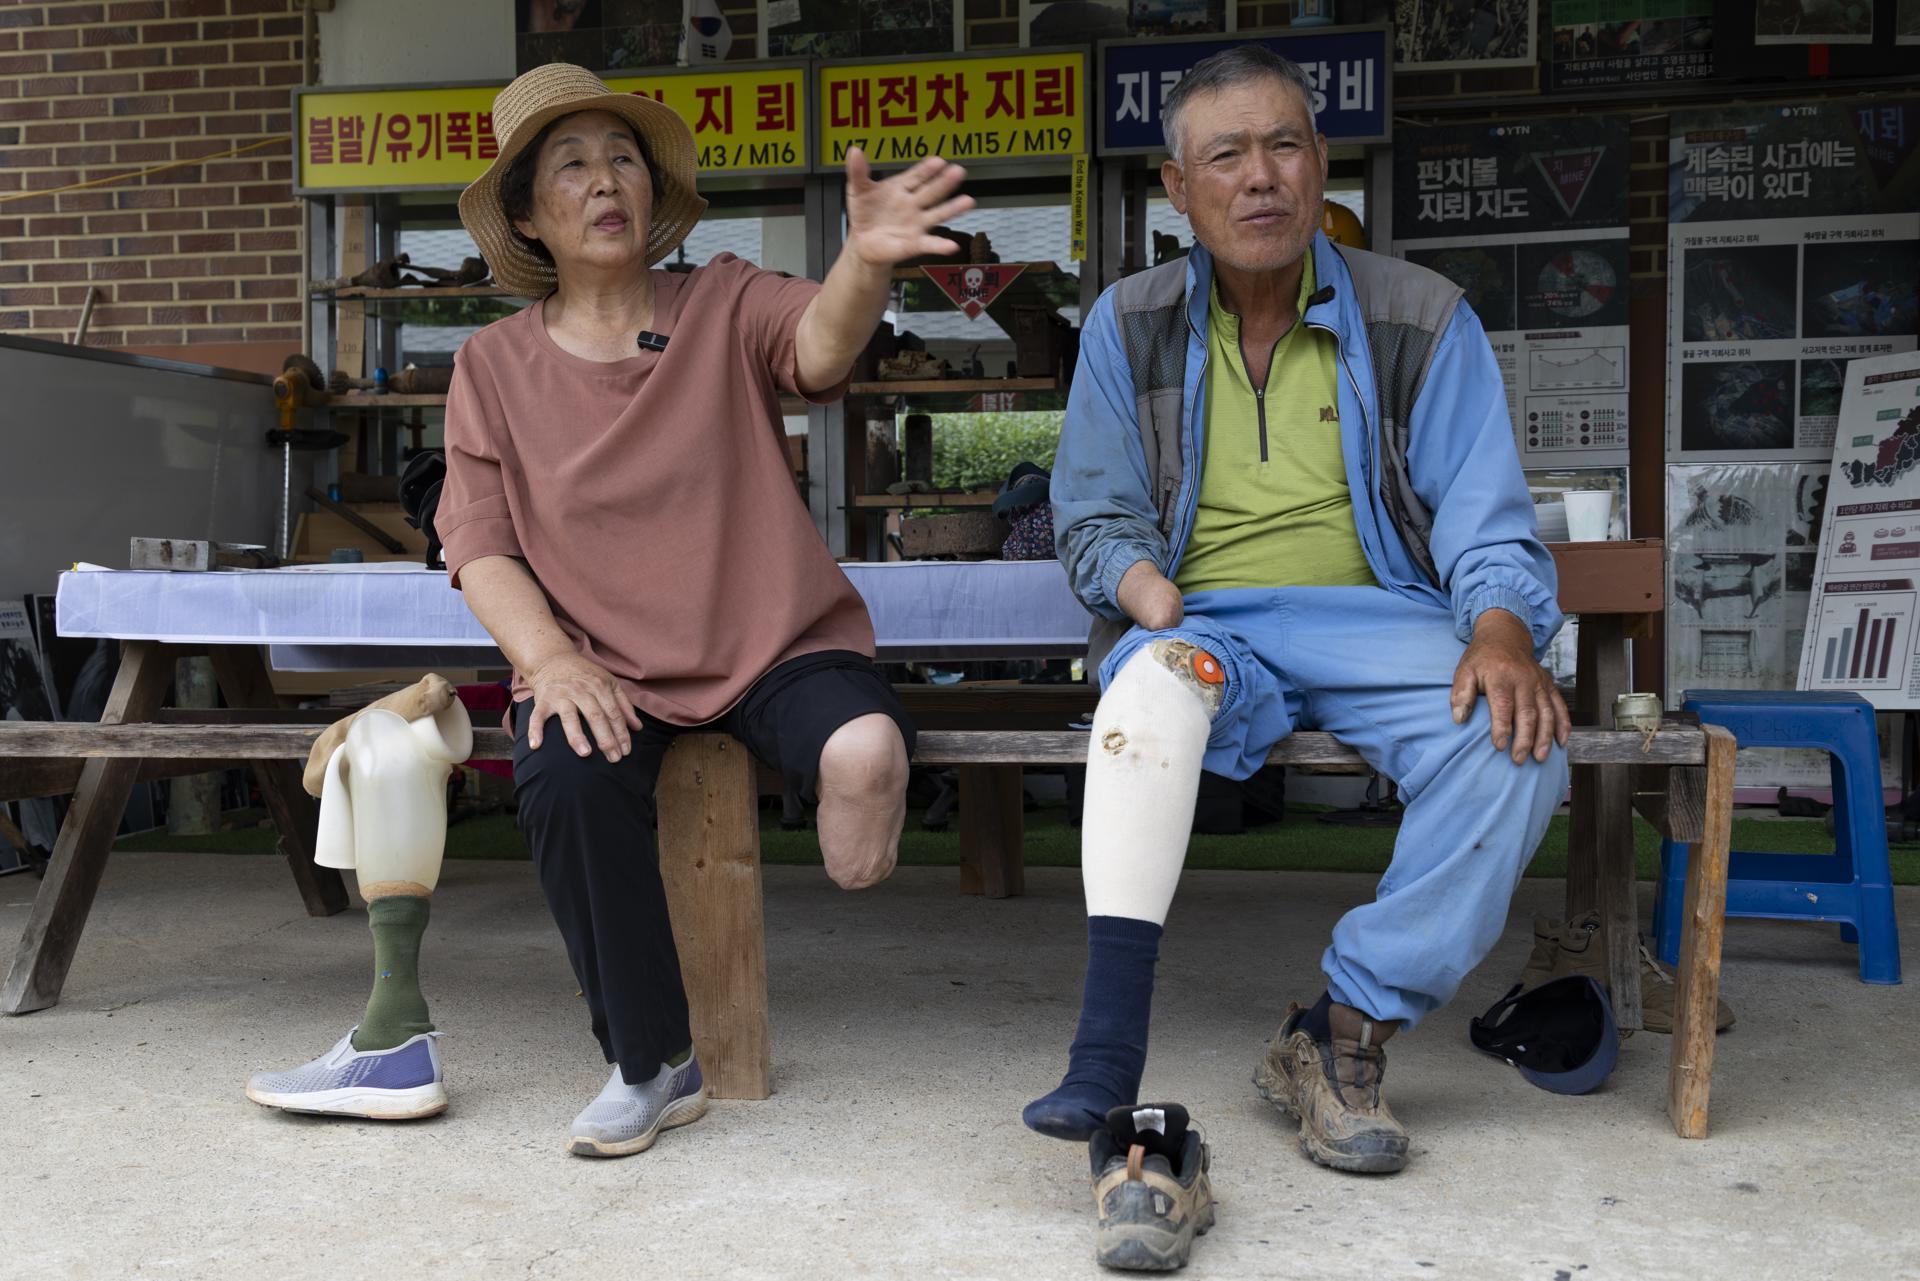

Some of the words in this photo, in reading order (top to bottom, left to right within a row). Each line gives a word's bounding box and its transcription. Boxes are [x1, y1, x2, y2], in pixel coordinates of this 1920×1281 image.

[830, 72, 969, 128] 대전차
[985, 66, 1075, 119] 지뢰
[1793, 106, 1818, 117] YTN
[892, 135, 928, 159] M6
[952, 131, 1000, 155] M15
[1023, 127, 1073, 152] M19
[1506, 125, 1531, 136] YTN
[749, 142, 796, 165] M16
[1076, 159, 1085, 174] End
[1685, 144, 1754, 174] 계속된
[1761, 139, 1857, 170] 사고에는
[1076, 175, 1084, 188] the
[1417, 156, 1499, 190] 펀치볼
[1683, 173, 1755, 201] 맥락이
[1762, 171, 1813, 199] 있다
[1075, 190, 1084, 218] Korean
[1418, 191, 1471, 222] 지뢰
[1476, 188, 1530, 219] 지도
[1075, 220, 1083, 235] War
